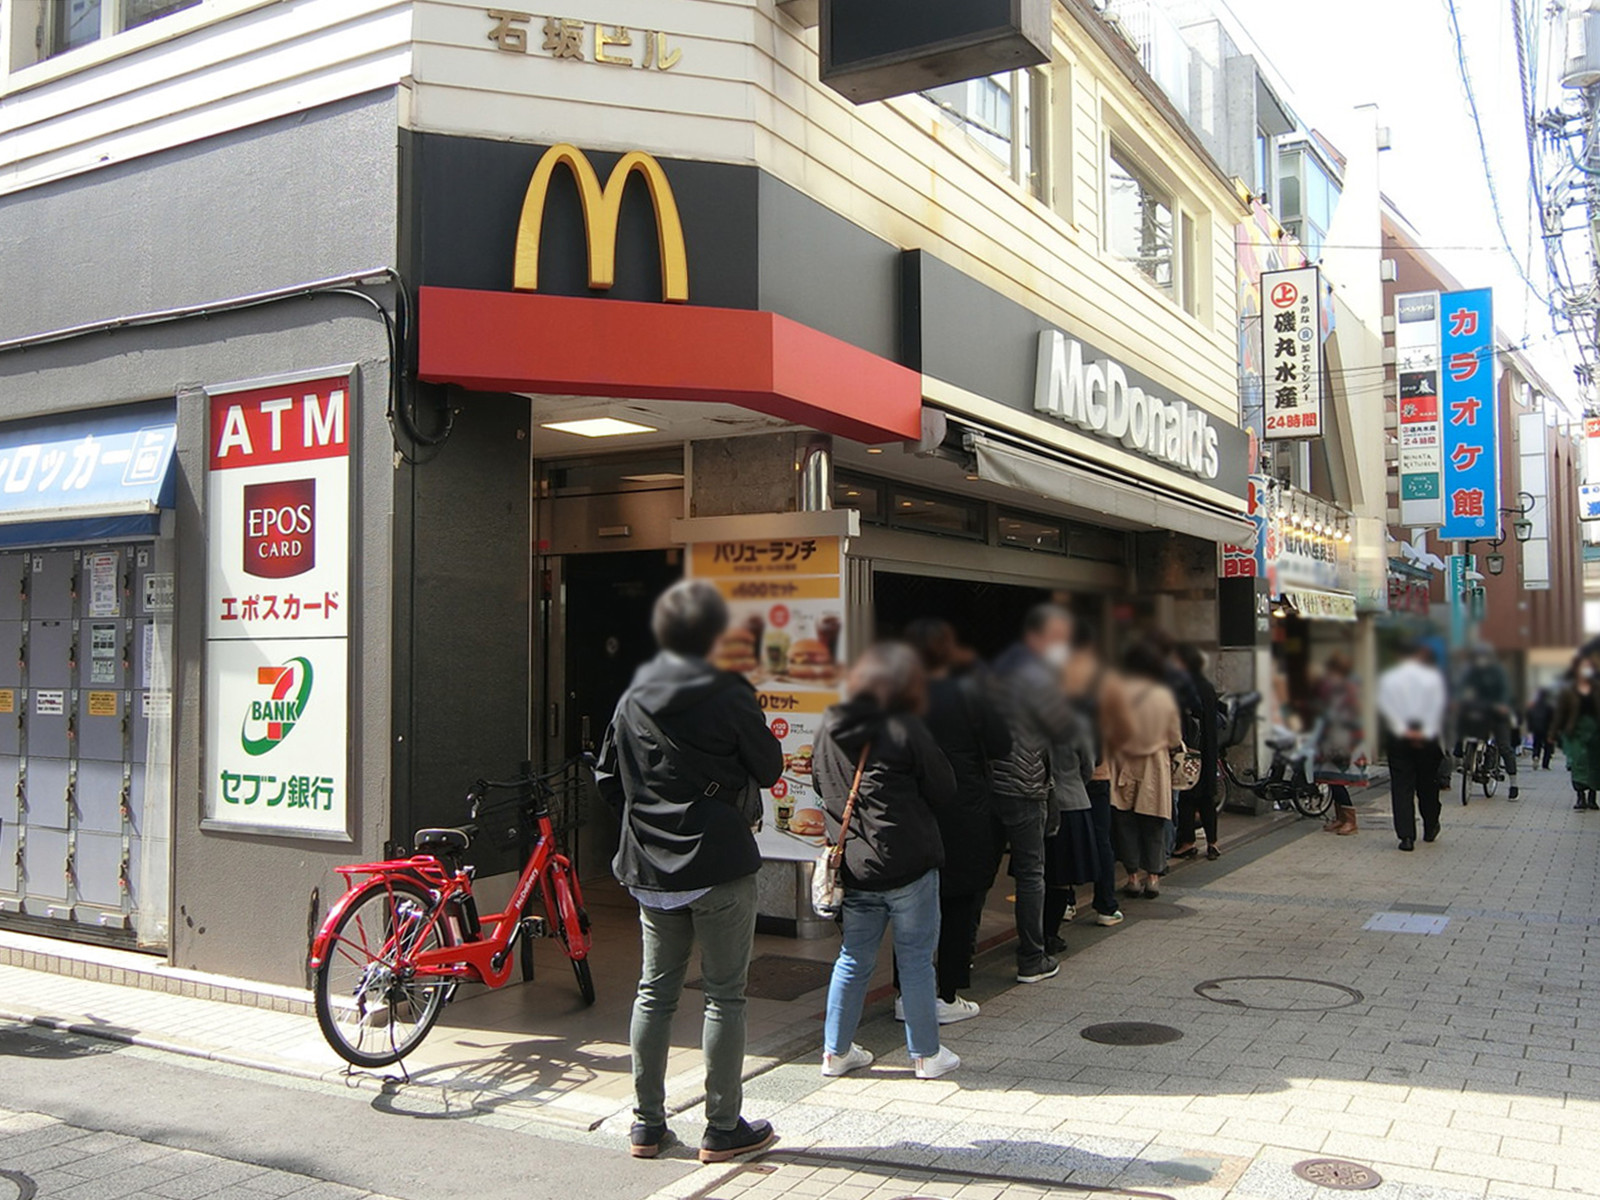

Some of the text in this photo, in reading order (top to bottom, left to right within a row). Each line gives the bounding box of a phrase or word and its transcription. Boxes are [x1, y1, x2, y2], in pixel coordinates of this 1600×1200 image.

[487, 9, 682, 71] 石坂ビル
[1274, 311, 1298, 409] 磯丸水産
[1034, 329, 1219, 480] McDonald's
[1267, 413, 1317, 430] 24時間
[1449, 308, 1484, 517] カラオケ館
[217, 390, 345, 458] ATM
[0, 434, 132, 494] ロッカー
[249, 505, 312, 537] EPOS
[258, 540, 303, 559] CARD
[713, 540, 817, 563] バリューランチ
[220, 591, 340, 621] エポスカード
[251, 701, 297, 721] BANK
[756, 694, 799, 710] 0セット
[220, 769, 334, 811] セブン銀行
